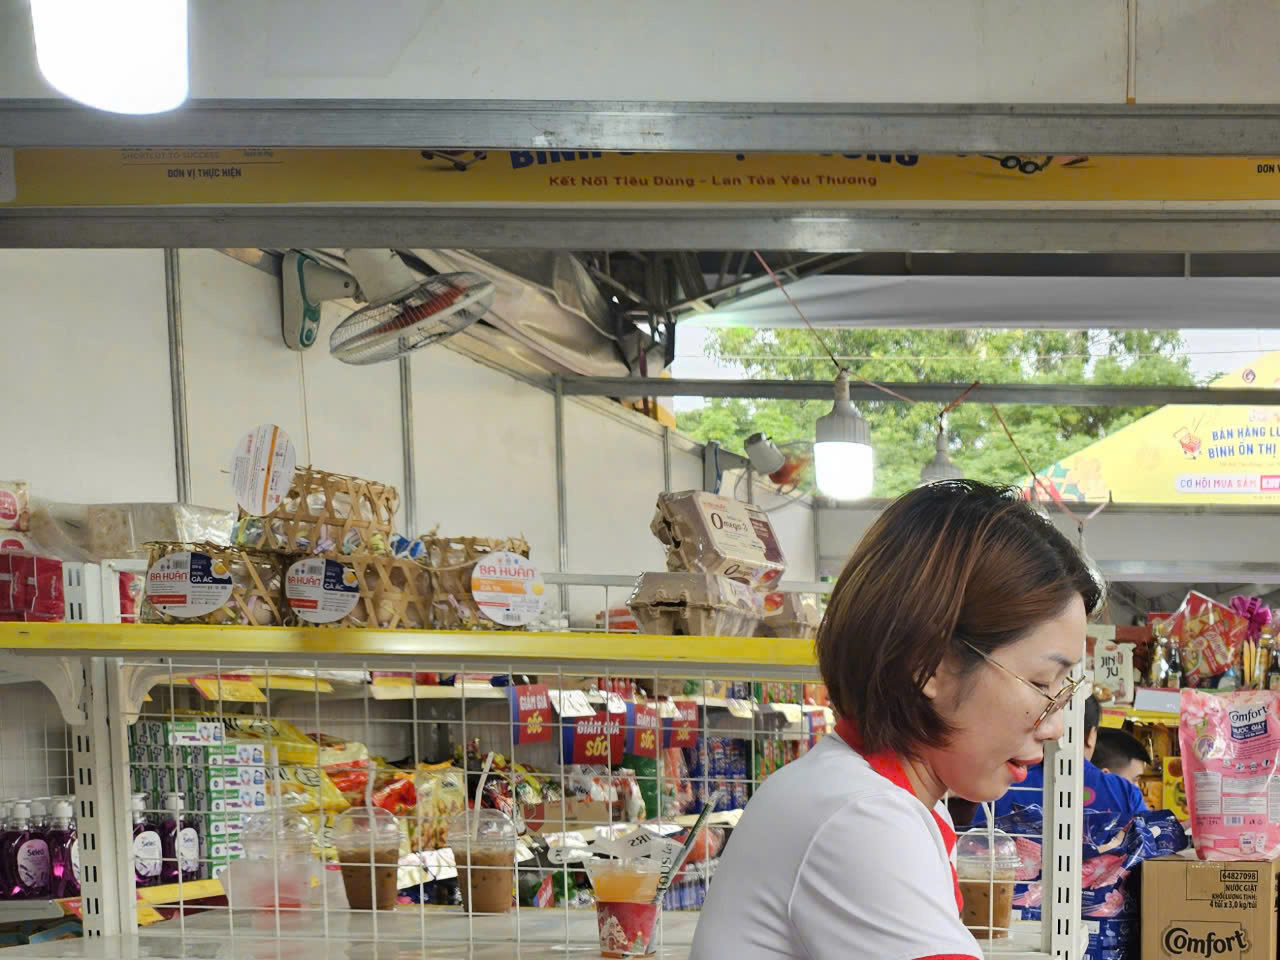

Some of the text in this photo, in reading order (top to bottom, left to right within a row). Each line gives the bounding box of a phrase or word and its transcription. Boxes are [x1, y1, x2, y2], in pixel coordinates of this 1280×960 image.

[549, 175, 577, 186] Kết
[615, 176, 649, 186] Tiêu
[653, 175, 695, 188] Dùng
[711, 175, 742, 186] Lan
[1229, 706, 1267, 723] Comfort
[1222, 872, 1256, 881] 64827098
[1165, 927, 1248, 959] Comfort
